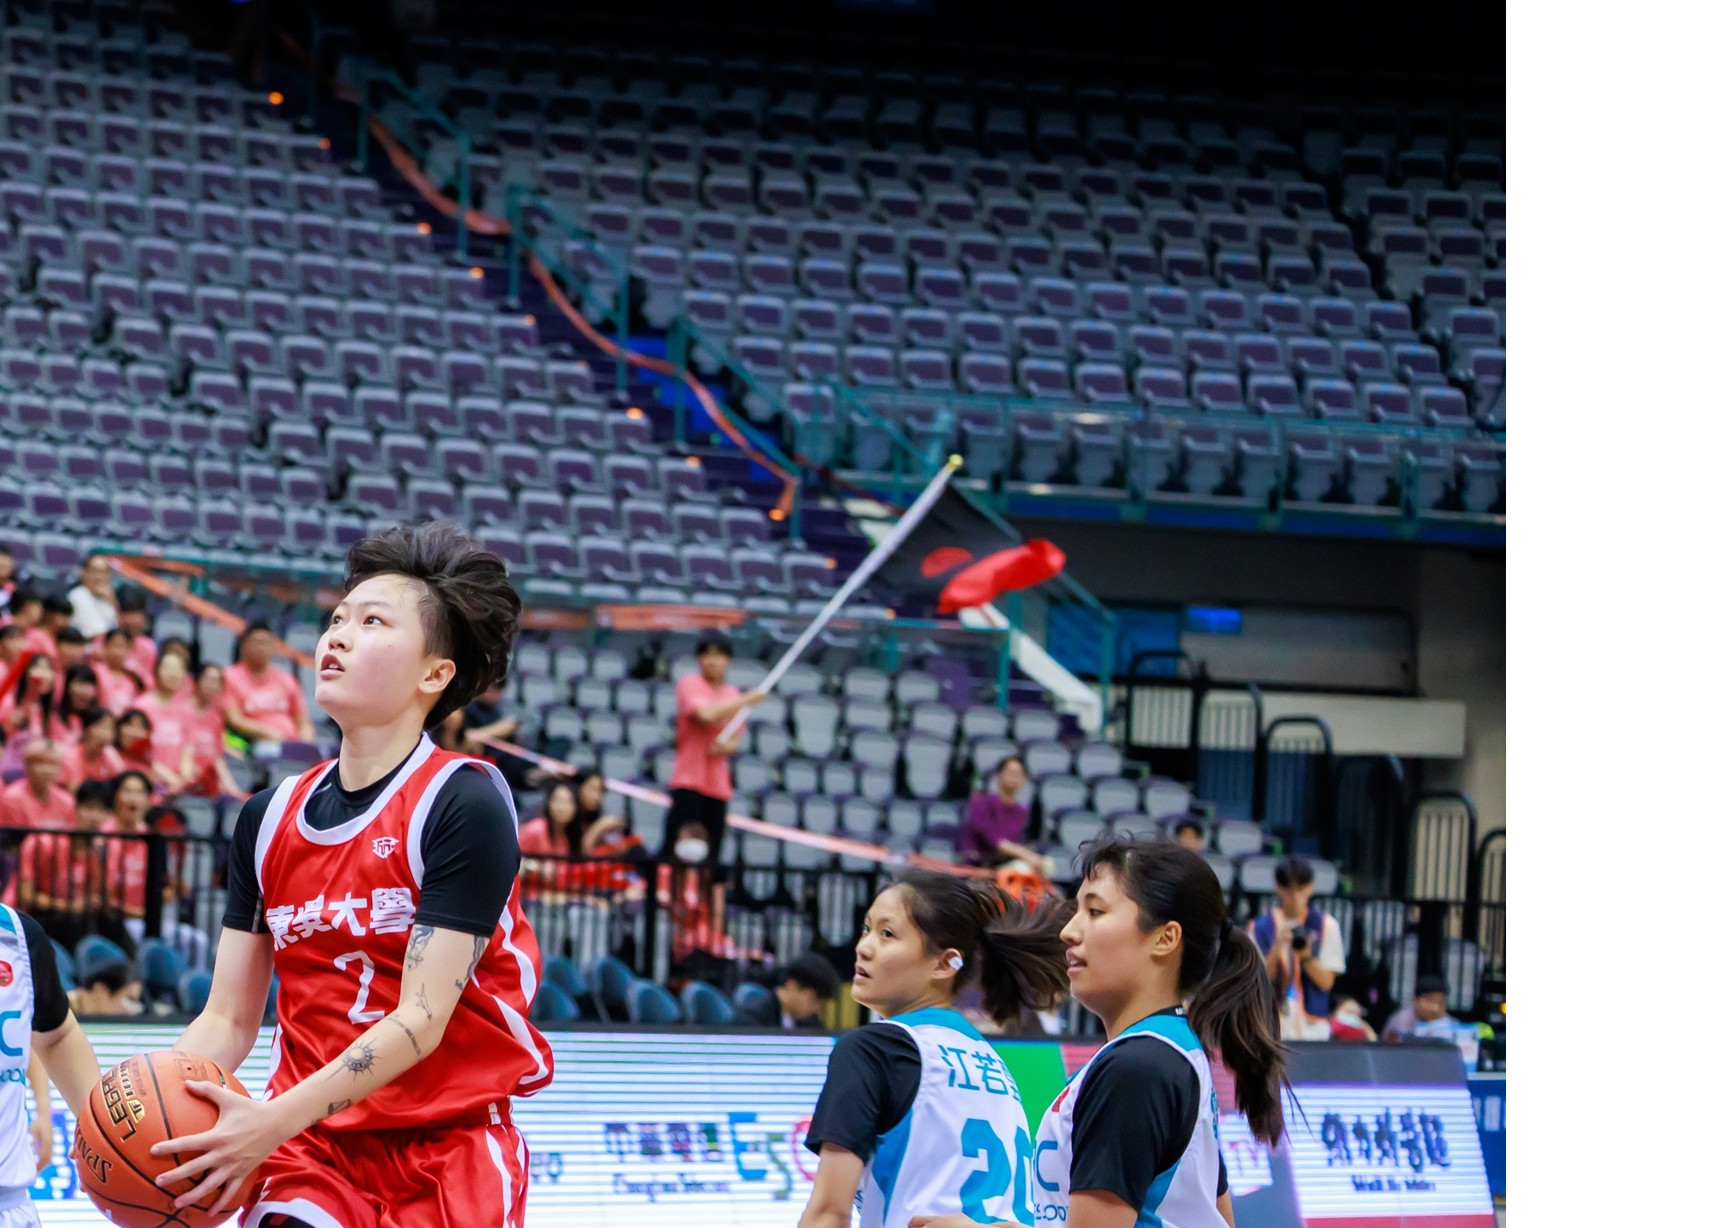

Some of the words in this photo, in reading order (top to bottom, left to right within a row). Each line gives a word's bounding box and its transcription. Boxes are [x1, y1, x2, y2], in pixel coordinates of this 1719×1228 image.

[266, 887, 416, 951] 東吳大學
[333, 950, 385, 1025] 2
[102, 1069, 137, 1143] LEGAC
